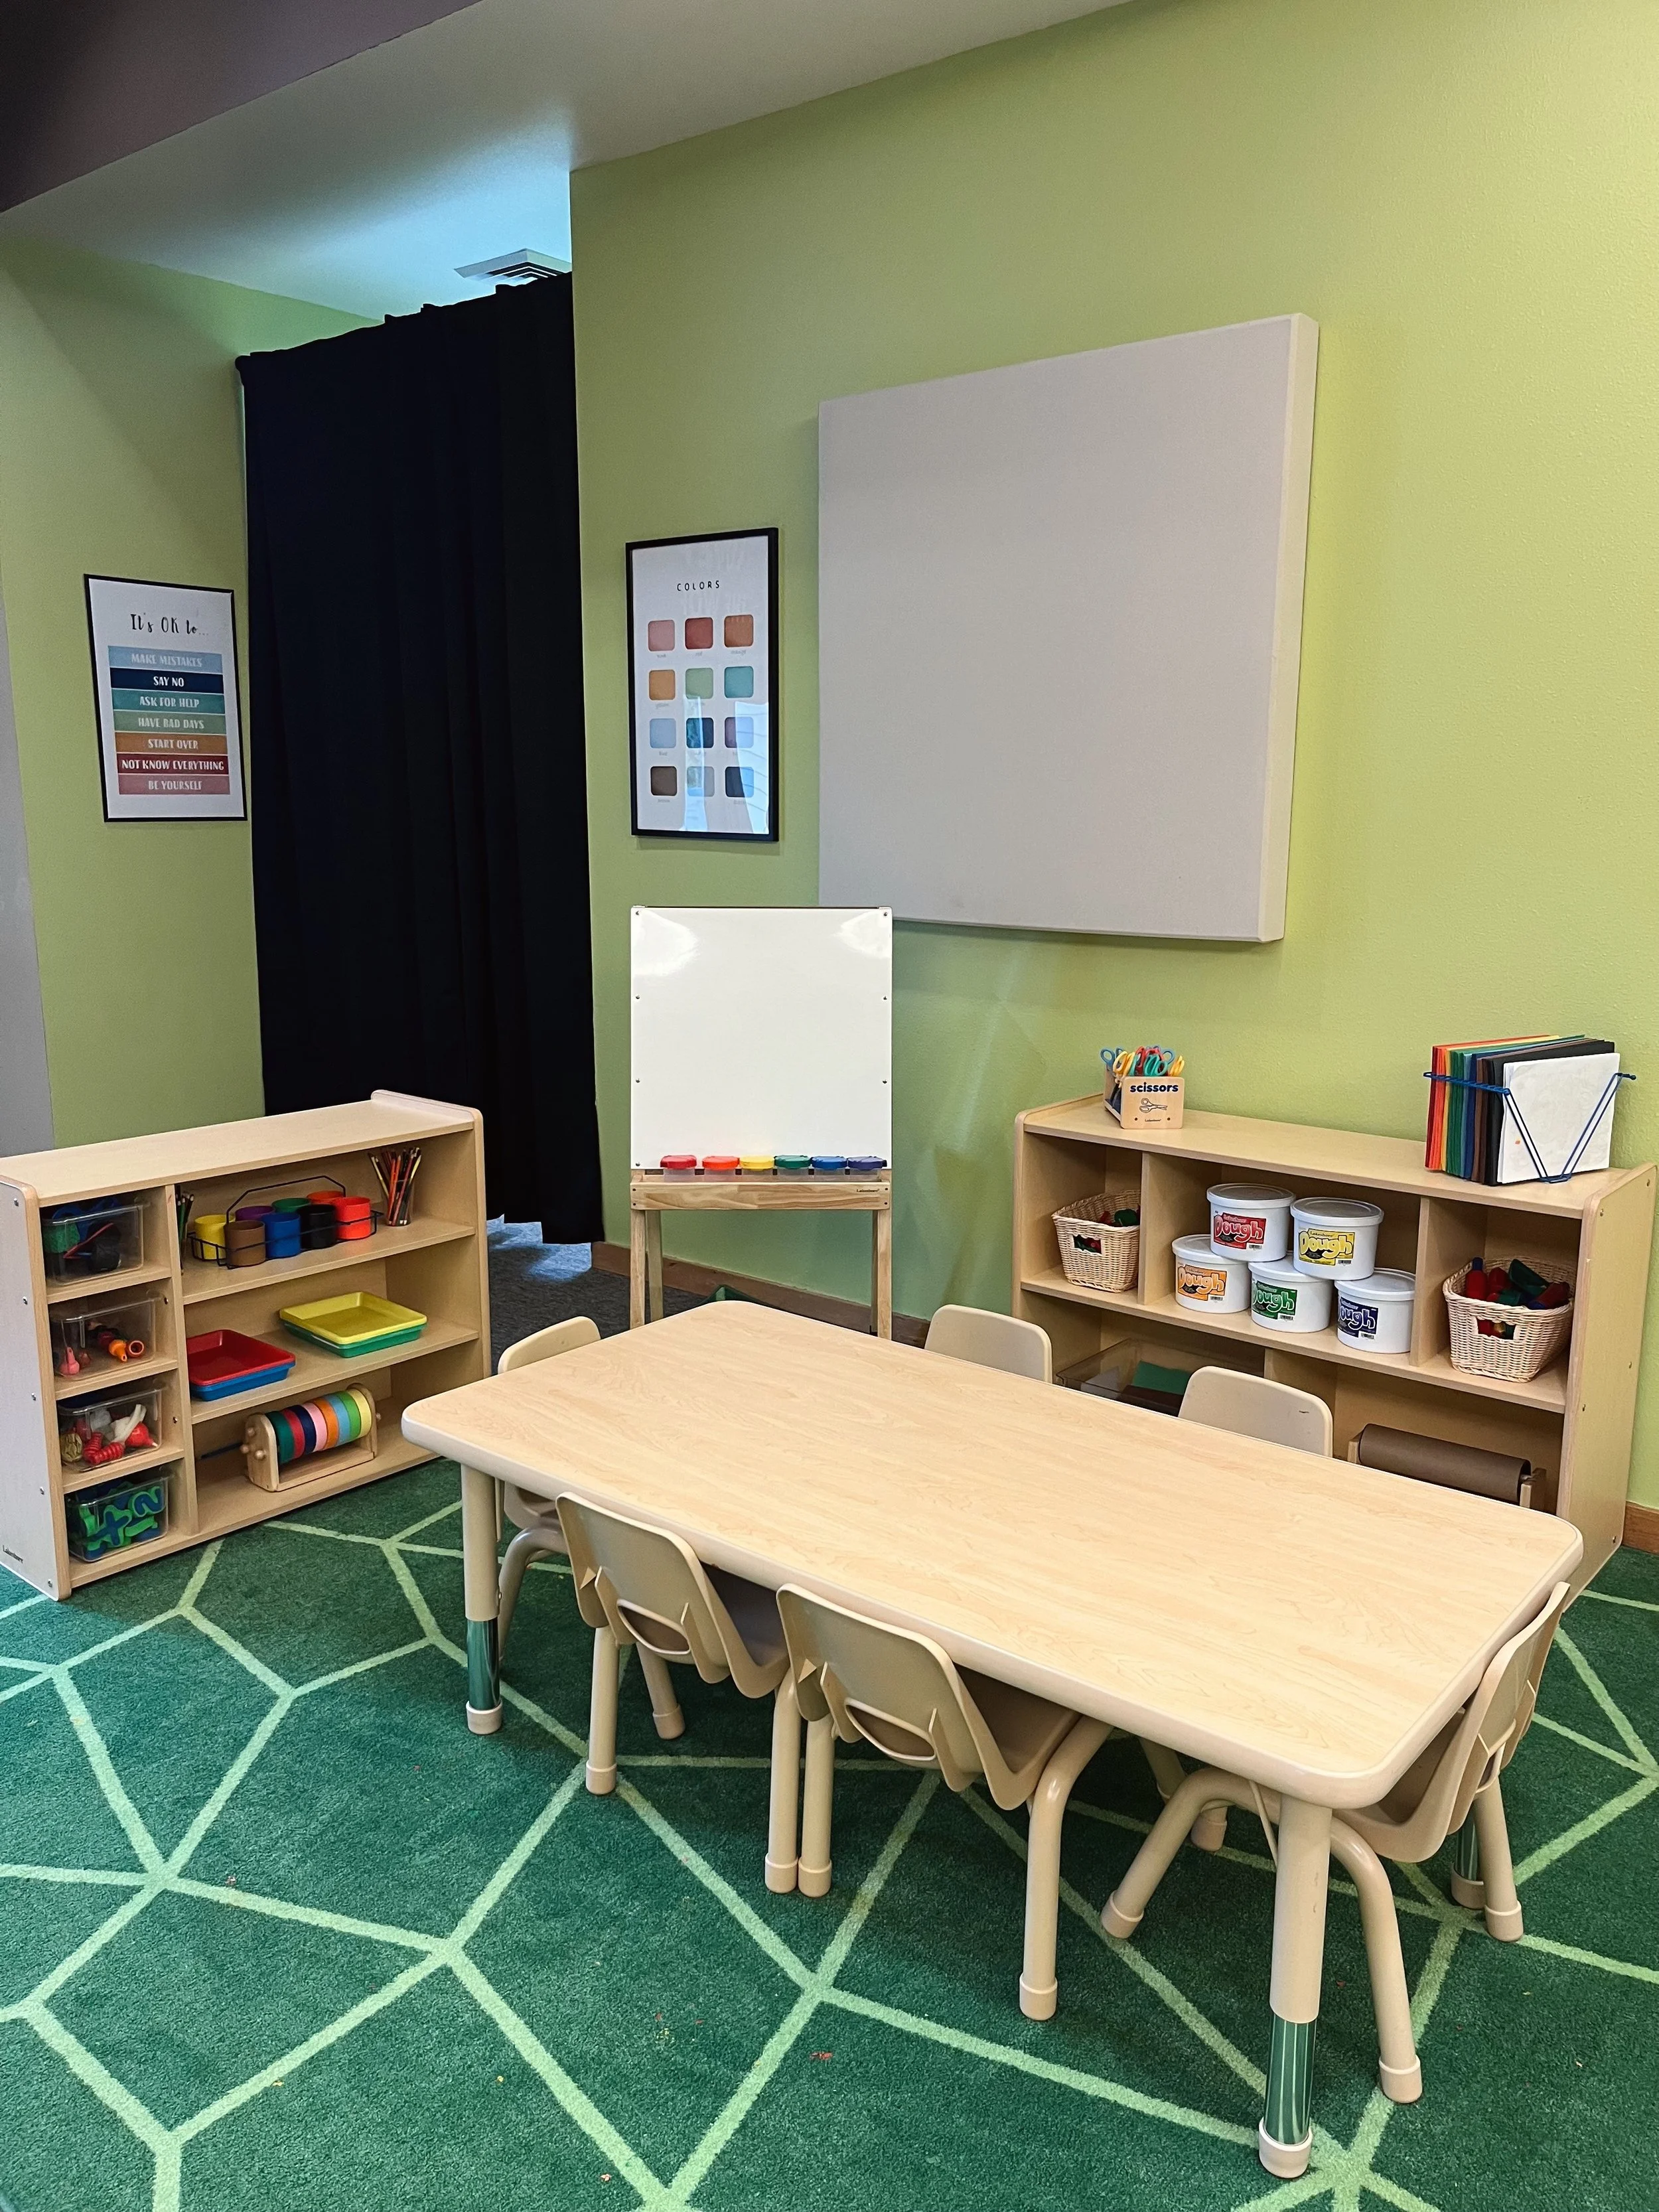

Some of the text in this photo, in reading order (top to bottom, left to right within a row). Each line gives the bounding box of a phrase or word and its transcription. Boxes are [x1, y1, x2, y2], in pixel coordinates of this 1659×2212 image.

[677, 580, 720, 591] COLORS
[131, 613, 154, 632] It's
[161, 617, 179, 633] OK
[131, 654, 202, 667] MAKE MISTAKES
[153, 676, 184, 687] SAY NO
[139, 696, 199, 708] ASK FOR HELP
[138, 717, 204, 729] HAVE BAD DAYS
[148, 739, 198, 749] START OVER
[121, 759, 224, 771] NOT KNOW EVERYTHING
[148, 780, 202, 790] BE YOURSELF
[1129, 1081, 1179, 1093] scissors
[1214, 1215, 1263, 1243] Dough
[1299, 1231, 1353, 1259] Dough
[1178, 1266, 1225, 1295] Dough
[1338, 1303, 1376, 1331] ough
